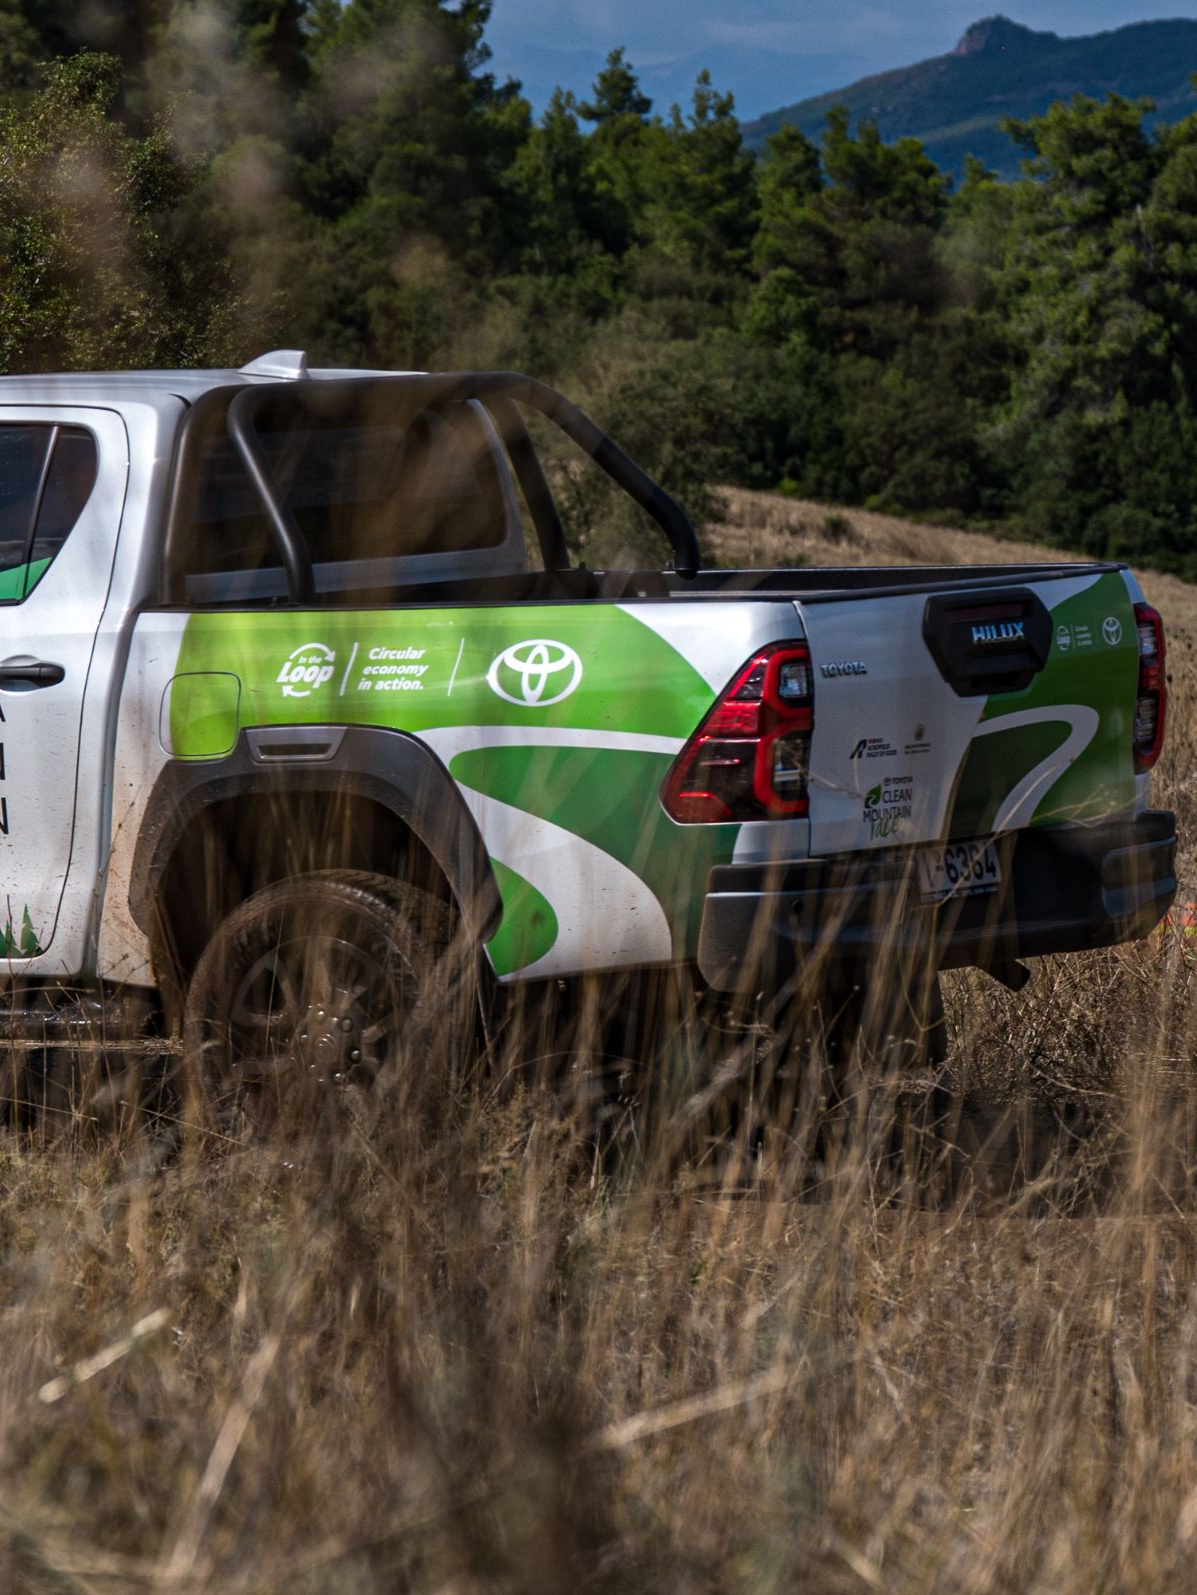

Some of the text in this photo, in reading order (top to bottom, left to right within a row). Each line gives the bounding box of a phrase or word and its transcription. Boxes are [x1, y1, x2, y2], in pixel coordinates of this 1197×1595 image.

[971, 621, 1025, 642] HILUX
[308, 655, 322, 664] the
[368, 646, 426, 660] Circular
[276, 661, 335, 688] Loop
[363, 664, 429, 677] economy
[821, 660, 868, 678] TOYOTA
[357, 676, 424, 690] in action.
[882, 788, 912, 804] CLEAN
[863, 805, 911, 823] MOUNTAIN
